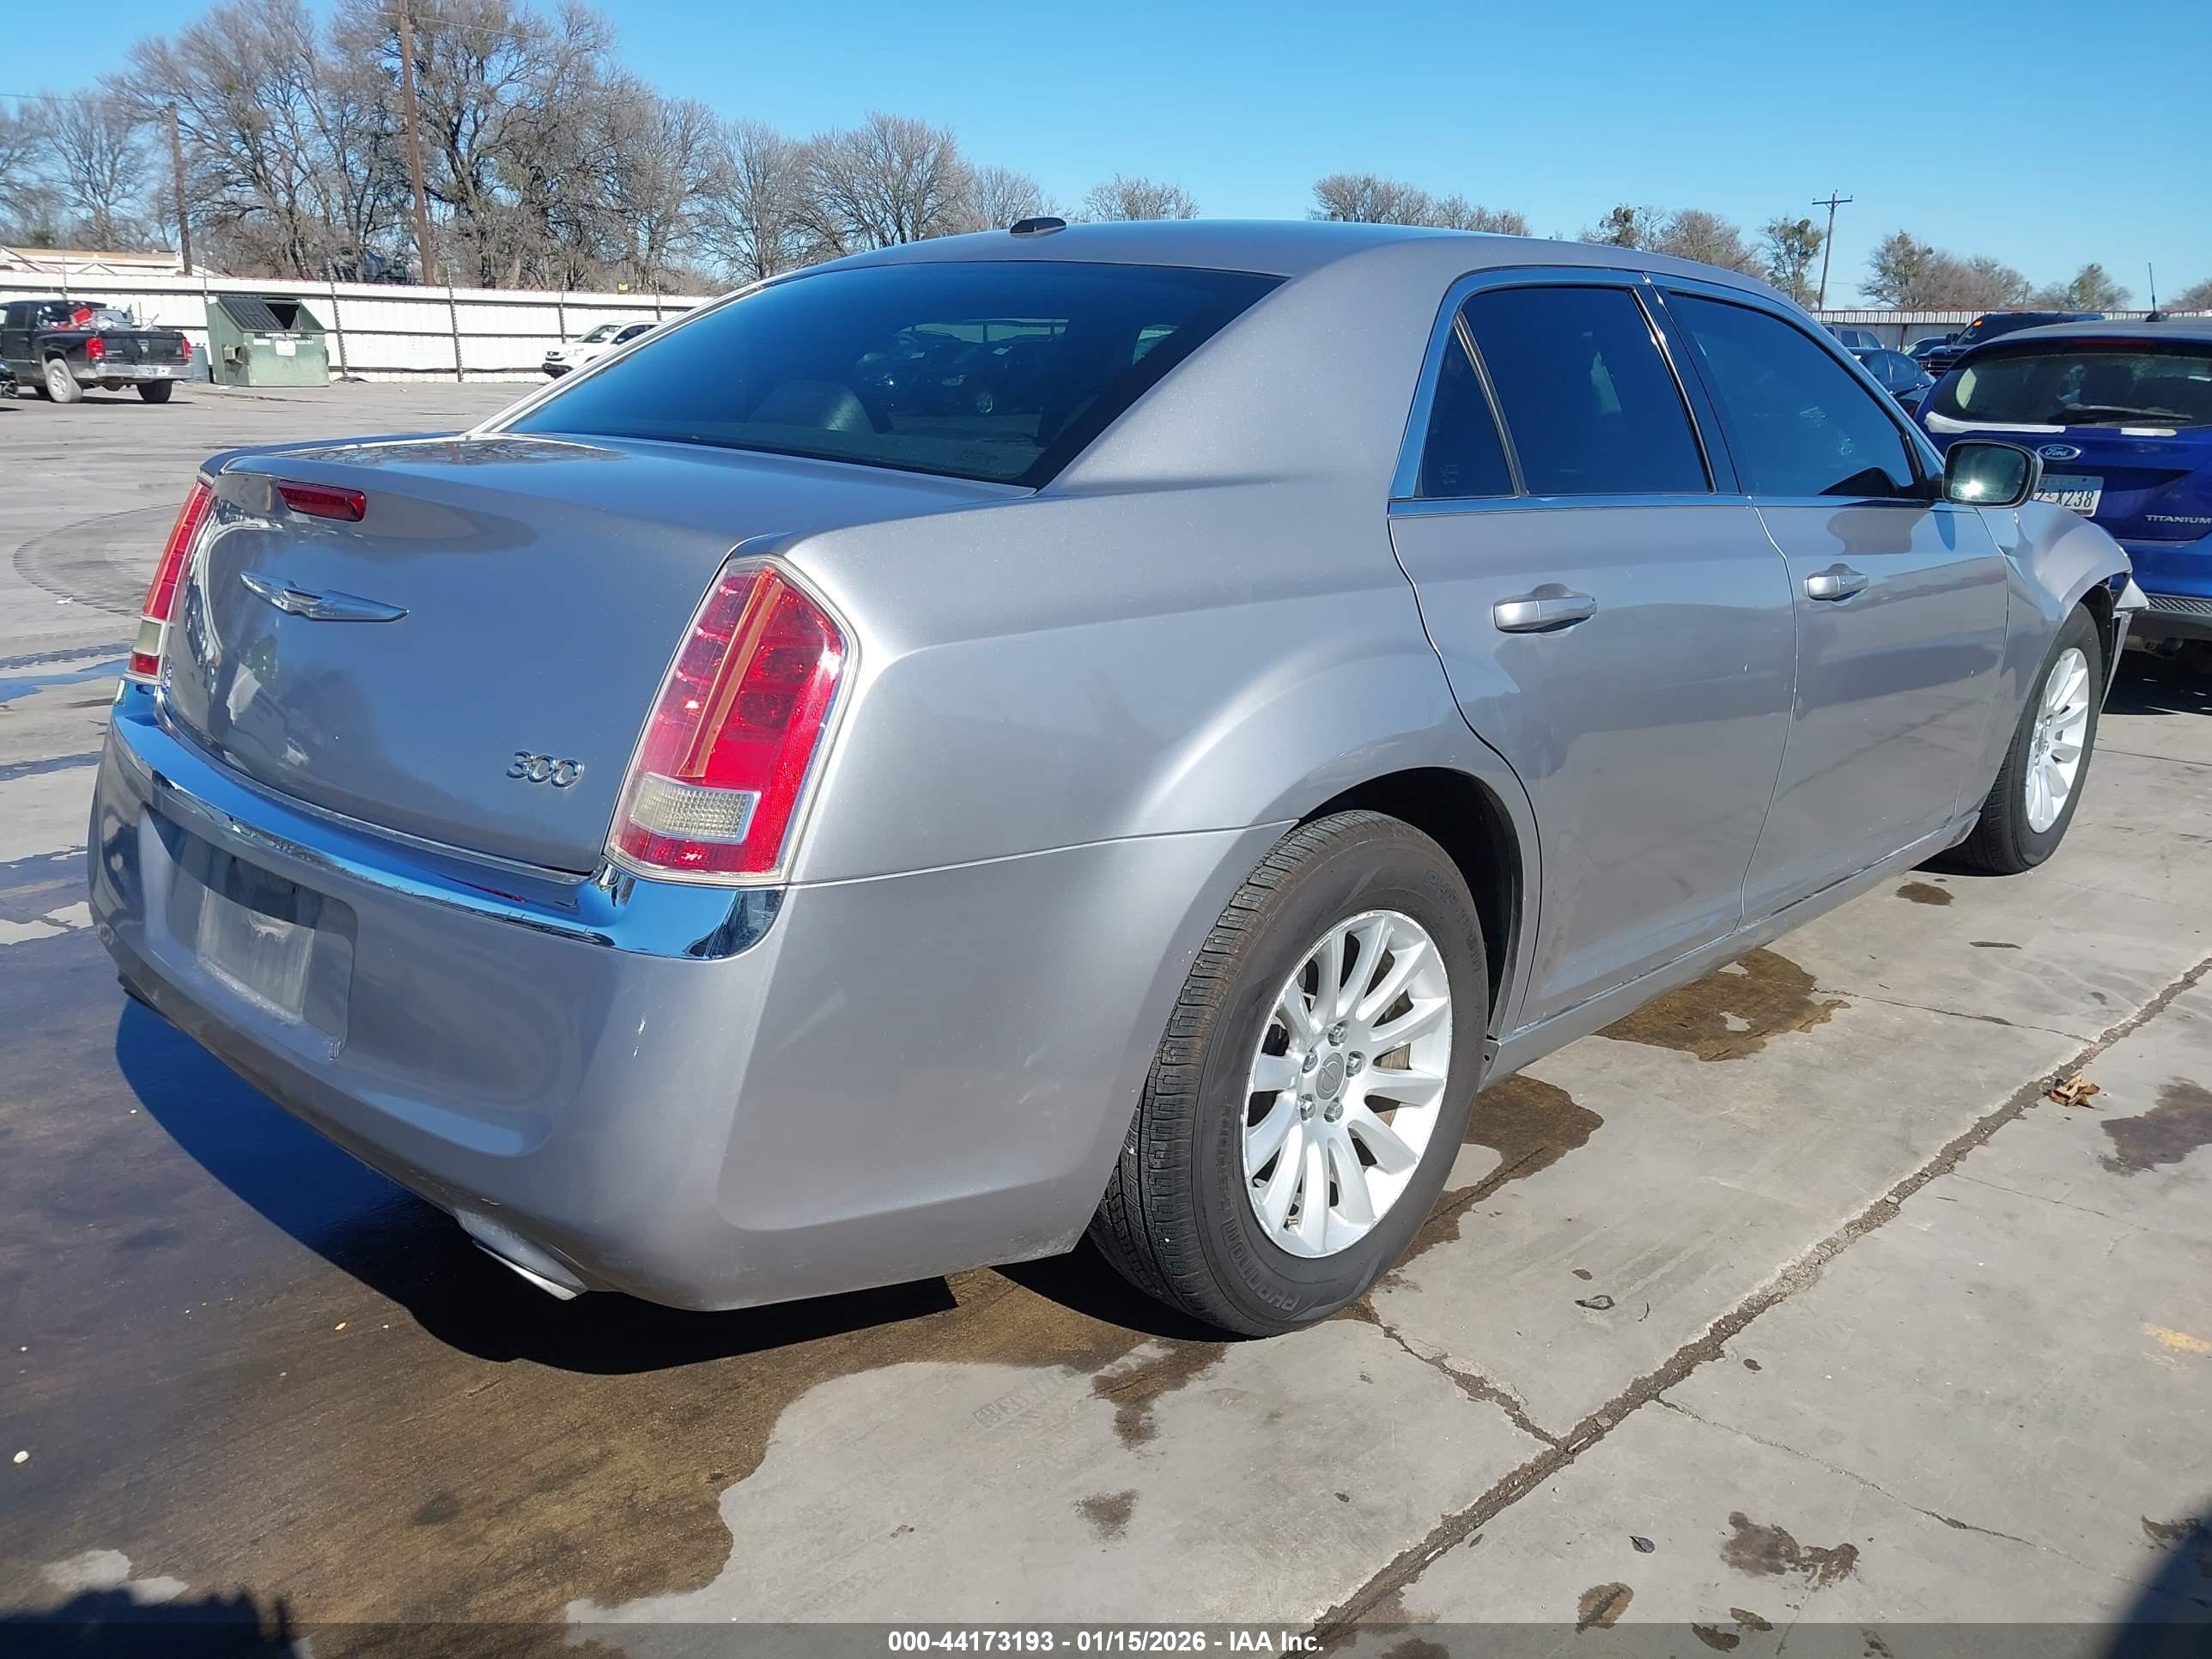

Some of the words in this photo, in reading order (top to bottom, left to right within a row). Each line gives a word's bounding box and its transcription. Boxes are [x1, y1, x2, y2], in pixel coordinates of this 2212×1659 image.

[2045, 447, 2069, 456] Ford
[2145, 515, 2212, 524] TITANIUM
[506, 750, 585, 789] 300
[1220, 1216, 1302, 1311] PHANTOM
